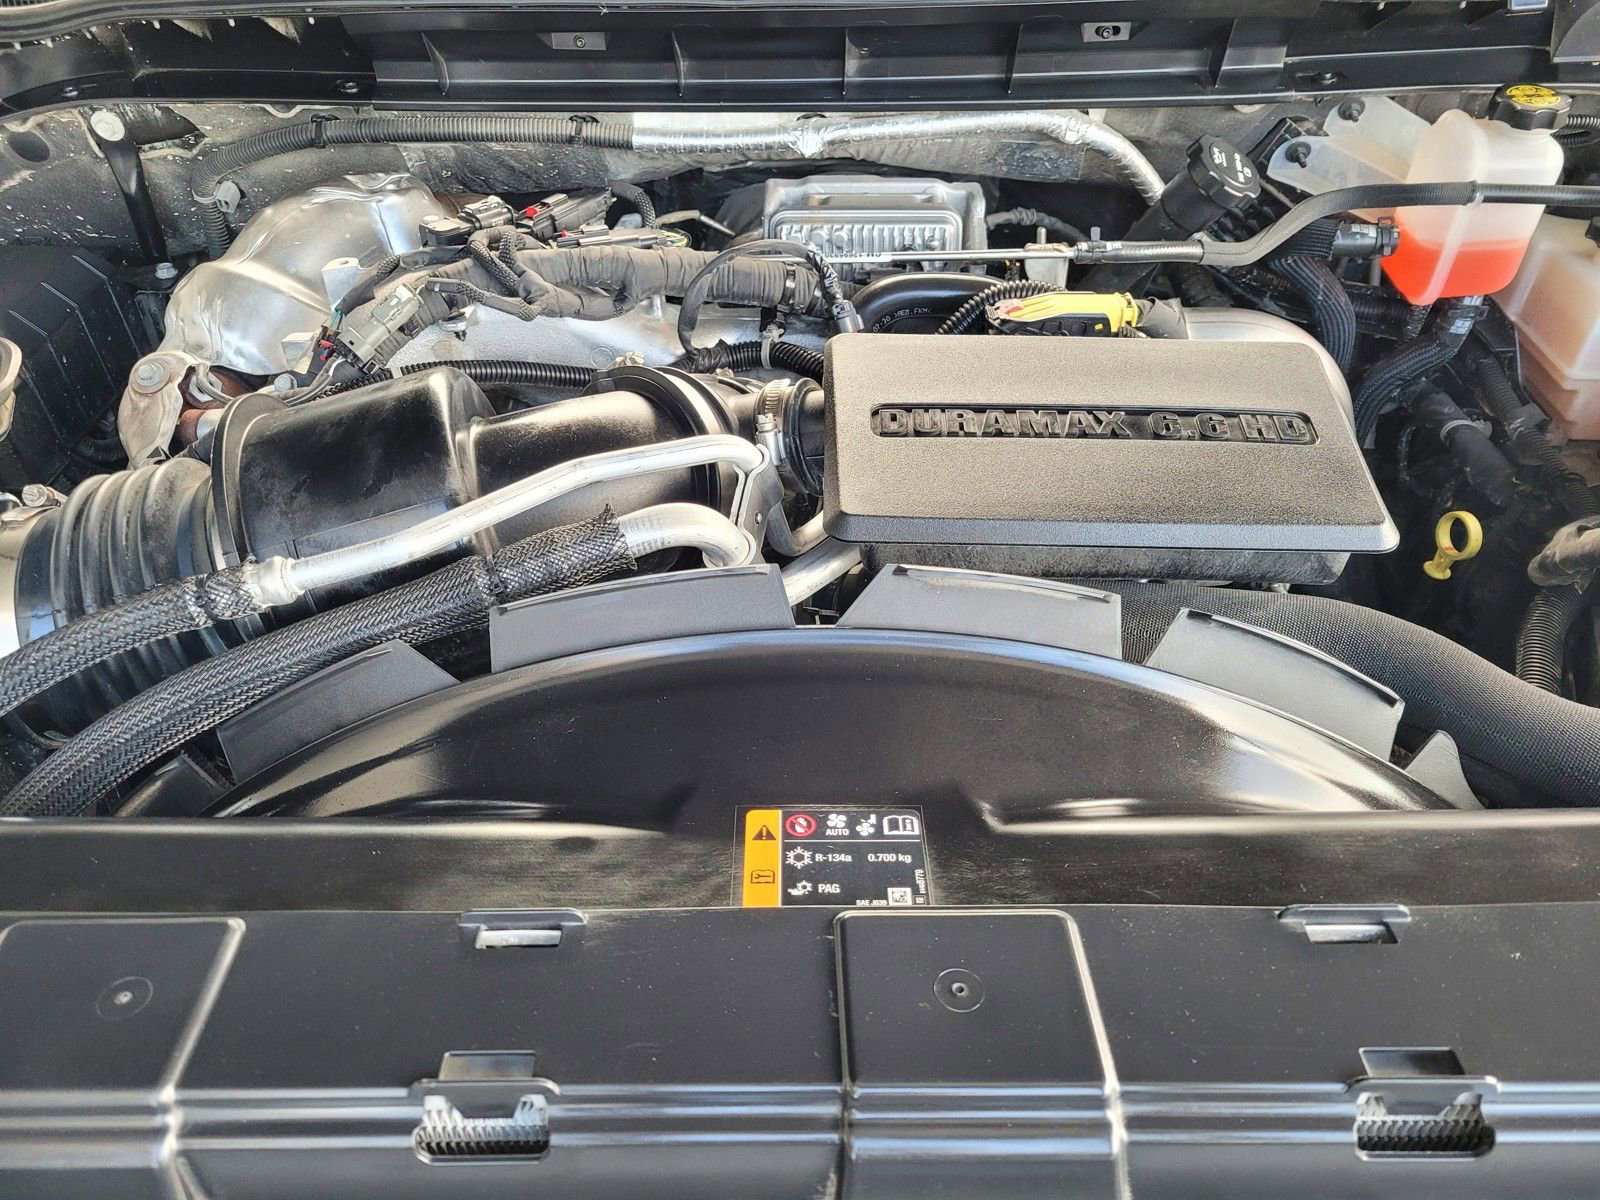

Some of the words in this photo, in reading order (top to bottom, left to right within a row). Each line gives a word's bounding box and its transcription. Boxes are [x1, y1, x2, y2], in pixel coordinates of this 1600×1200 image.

[878, 408, 1131, 438] DURAMAX
[1149, 411, 1231, 440] 6.6
[1238, 413, 1310, 442] HD
[825, 828, 849, 836] AUTO
[815, 853, 852, 863] R-134a
[867, 853, 897, 863] 0.700
[898, 853, 912, 864] kg
[818, 883, 841, 894] PAG
